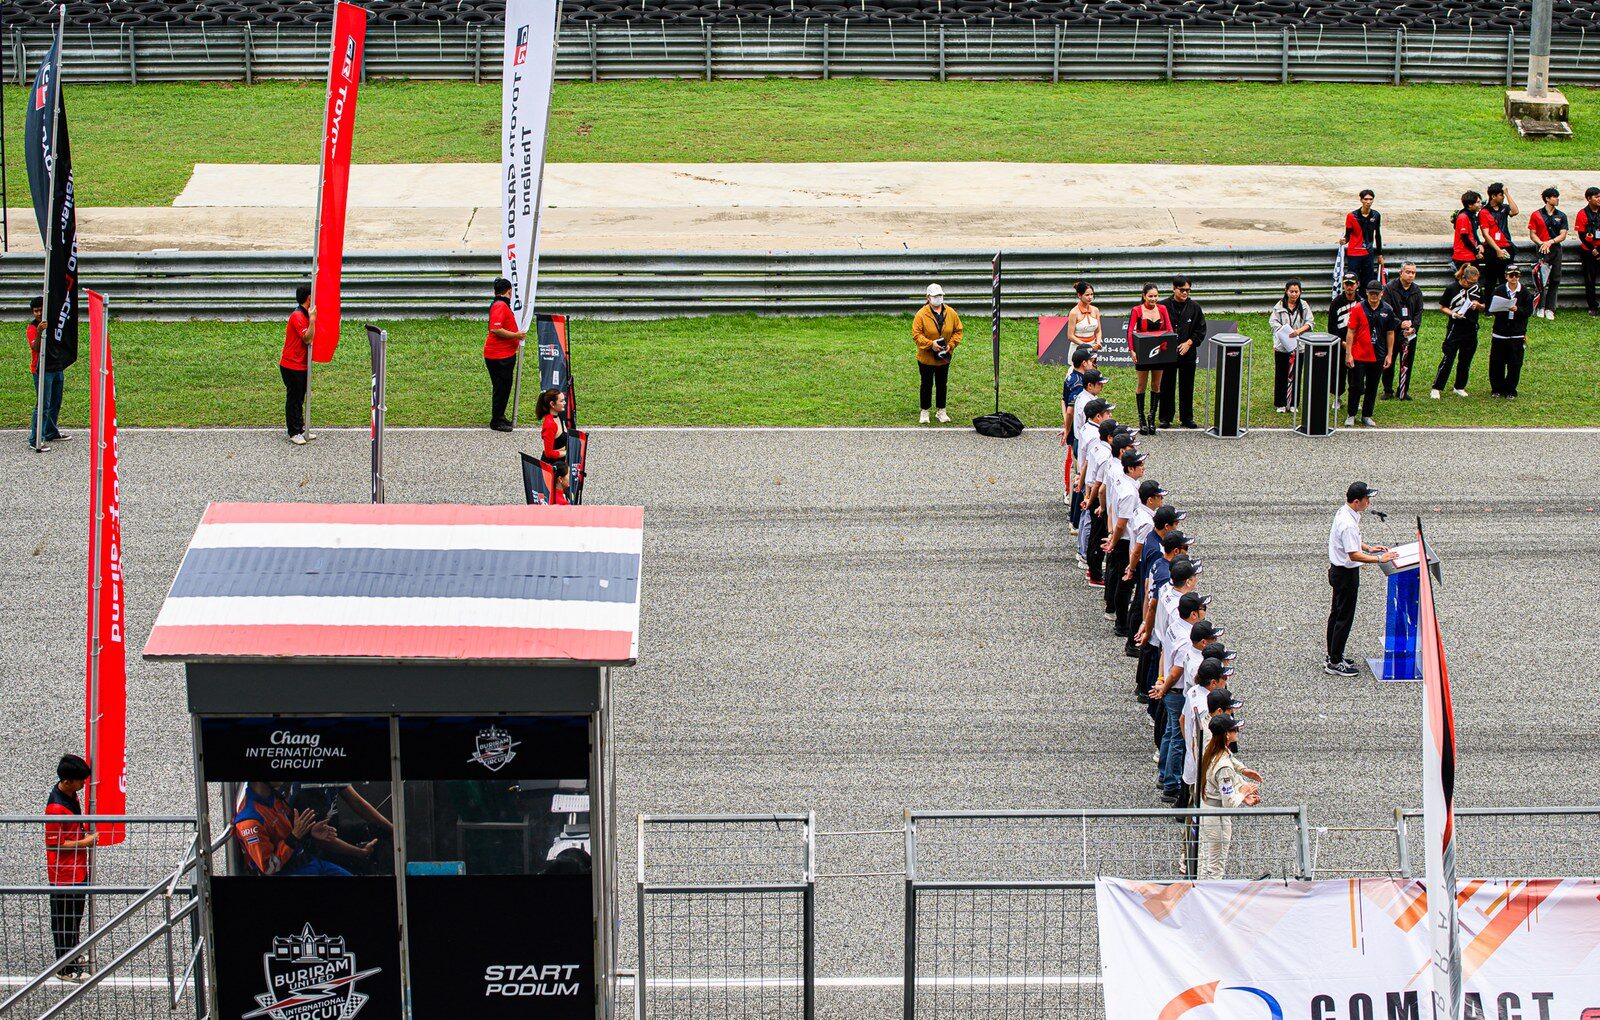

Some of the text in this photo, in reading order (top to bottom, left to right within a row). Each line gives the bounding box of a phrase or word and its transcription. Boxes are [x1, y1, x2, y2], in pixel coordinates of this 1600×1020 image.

[332, 85, 348, 160] TOYO
[270, 730, 320, 748] Chang
[245, 747, 347, 757] INTERNATIONAL
[271, 759, 324, 769] CIRCUIT
[275, 959, 349, 987] BURIRAM
[484, 964, 580, 981] START
[289, 973, 335, 990] UNITED
[485, 983, 580, 996] PODIUM
[285, 996, 346, 1016] INTERNATIONAL
[1311, 991, 1554, 1020] COMACT
